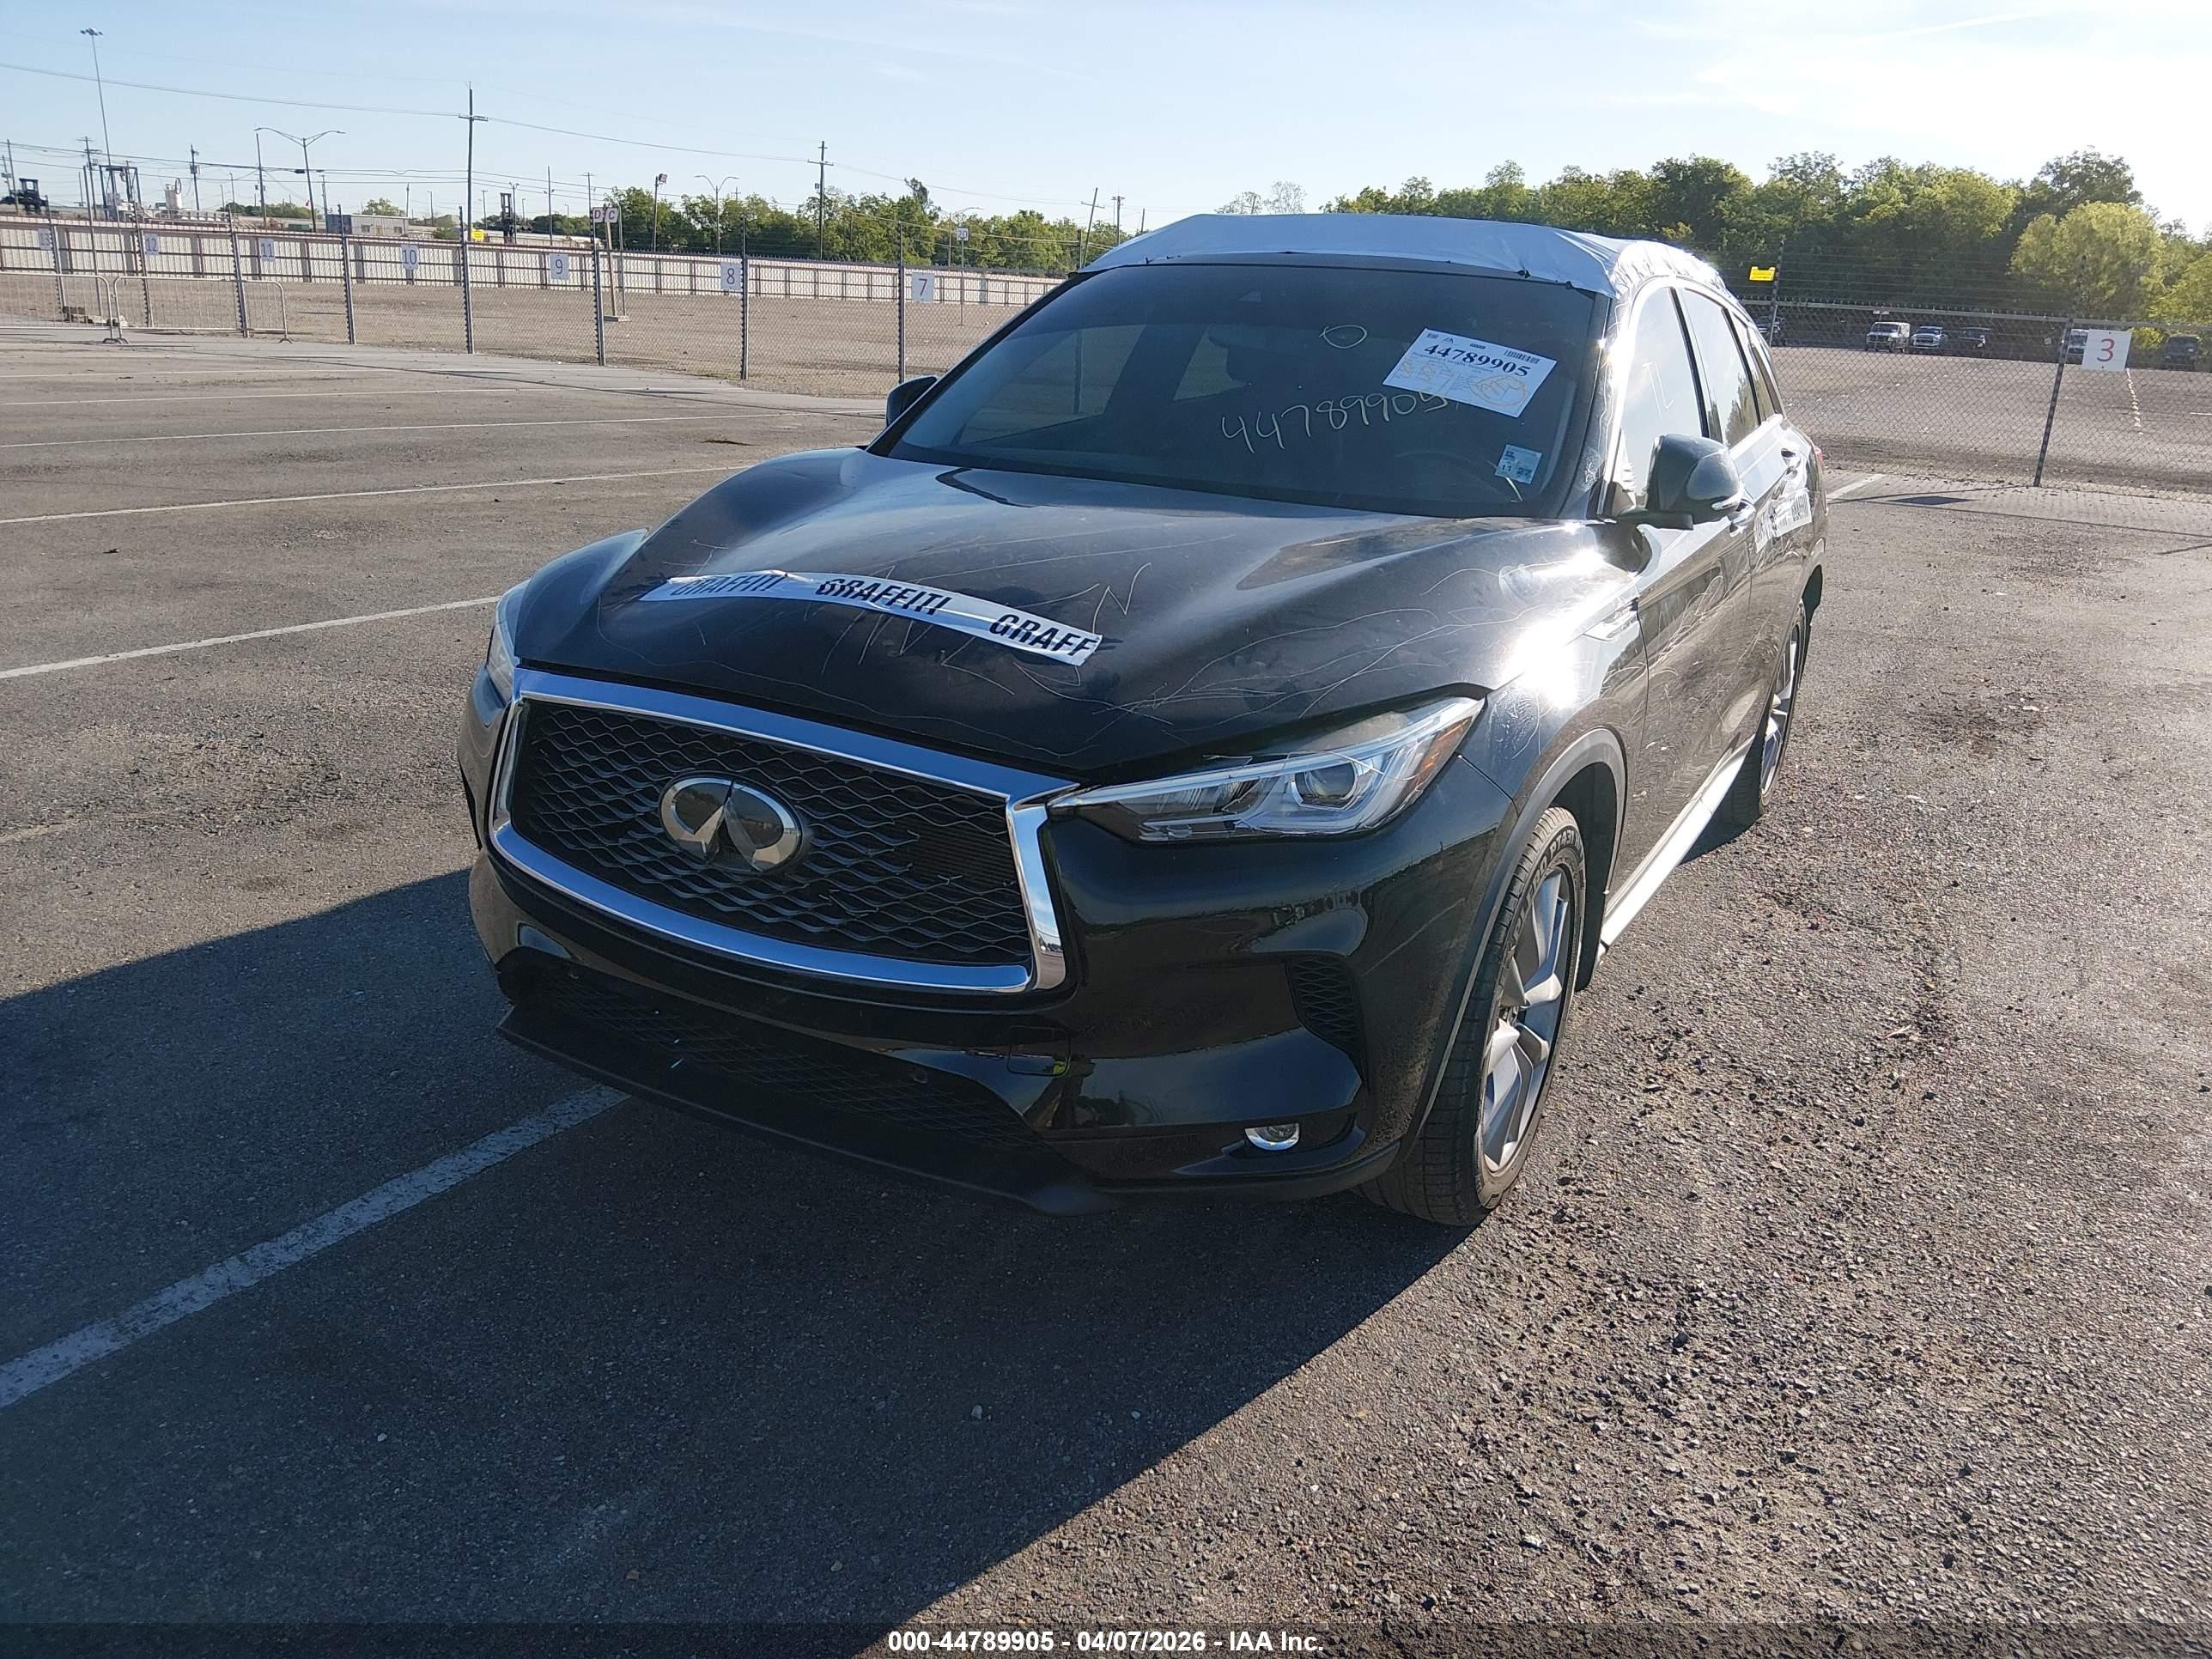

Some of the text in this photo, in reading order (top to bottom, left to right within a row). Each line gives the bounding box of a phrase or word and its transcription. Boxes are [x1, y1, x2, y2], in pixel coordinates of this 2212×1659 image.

[594, 210, 601, 220] D
[608, 210, 616, 220] C
[146, 238, 157, 252] 12
[260, 243, 274, 258] 11
[403, 249, 417, 265] 10
[555, 258, 563, 275] 9
[726, 267, 735, 285] 8
[918, 278, 928, 296] 7
[2096, 338, 2115, 362] 3
[1424, 343, 1532, 377] 44789905
[1221, 391, 1449, 453] 44789905
[670, 574, 1100, 657] GRAFFITI GRAFFITI GRAFF
